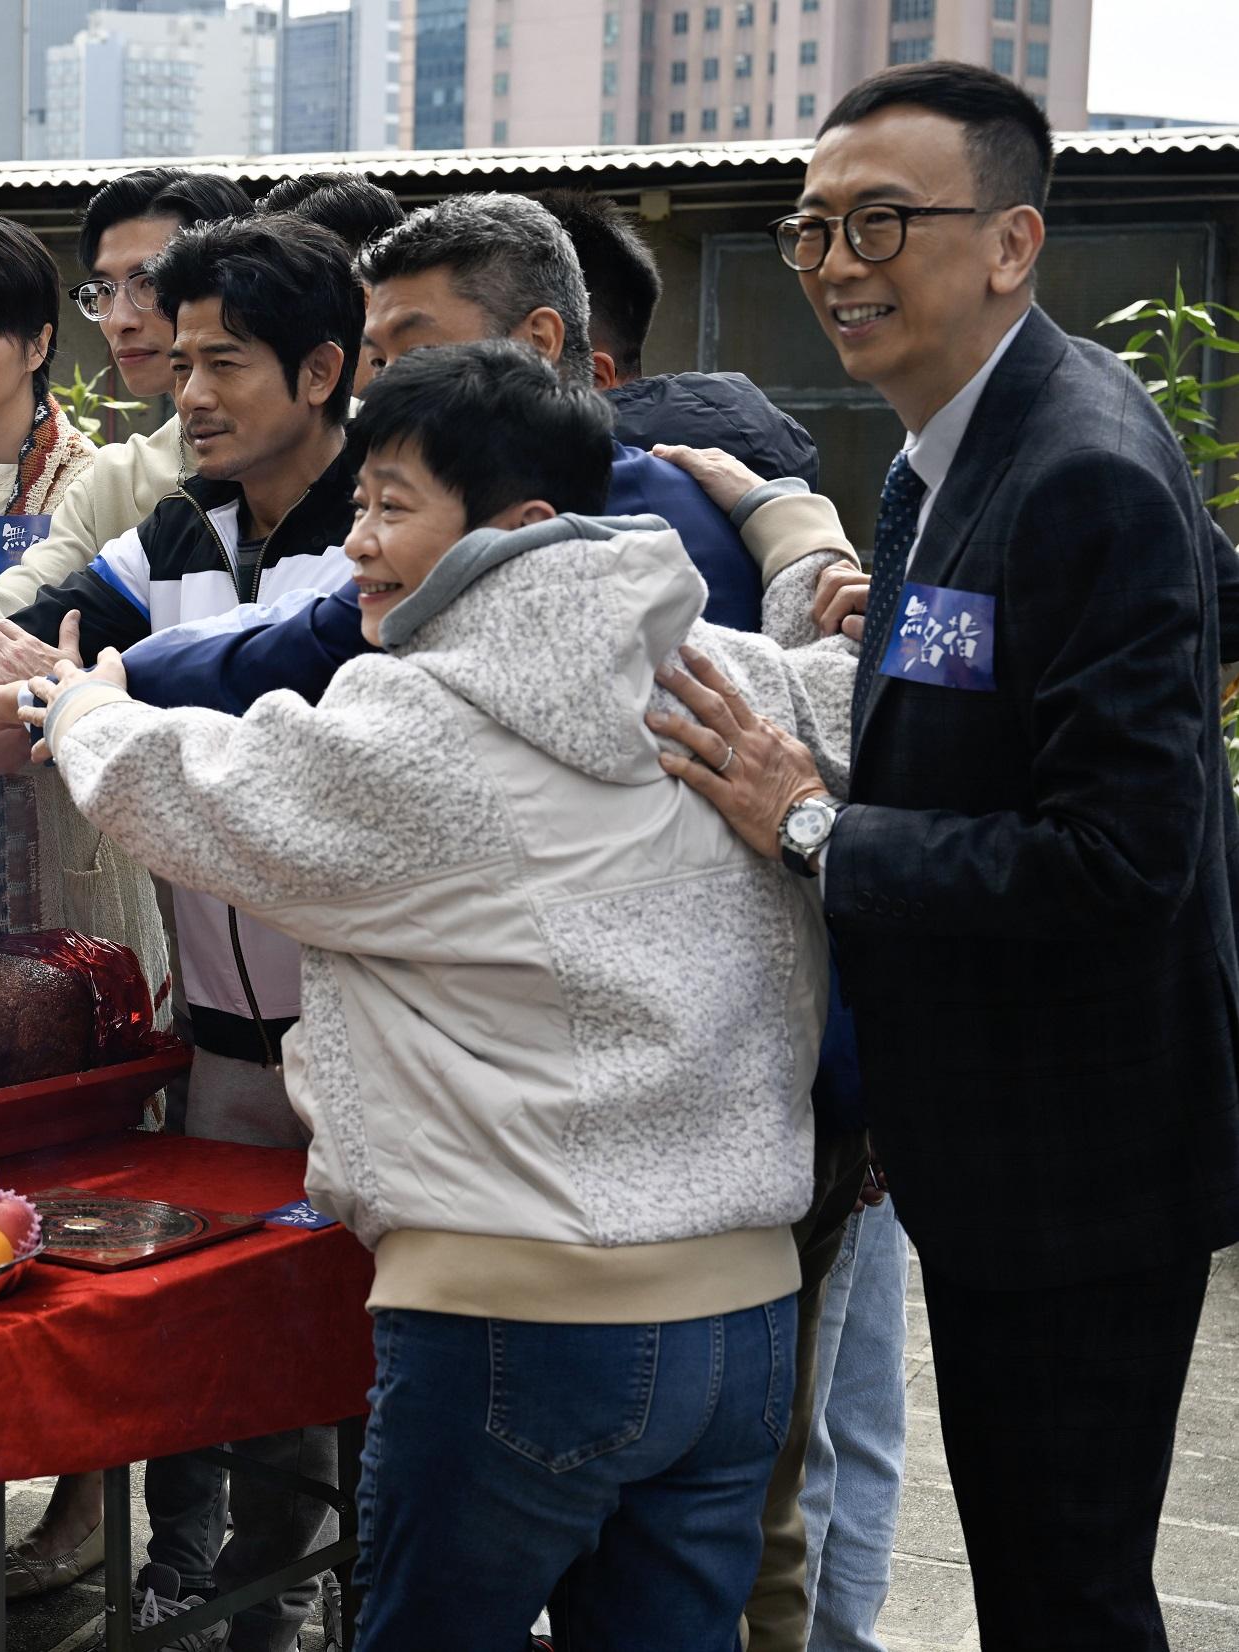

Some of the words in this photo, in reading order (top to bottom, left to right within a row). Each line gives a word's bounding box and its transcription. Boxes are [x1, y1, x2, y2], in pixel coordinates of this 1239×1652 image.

[2, 522, 47, 551] 無
[899, 594, 982, 673] 無名指
